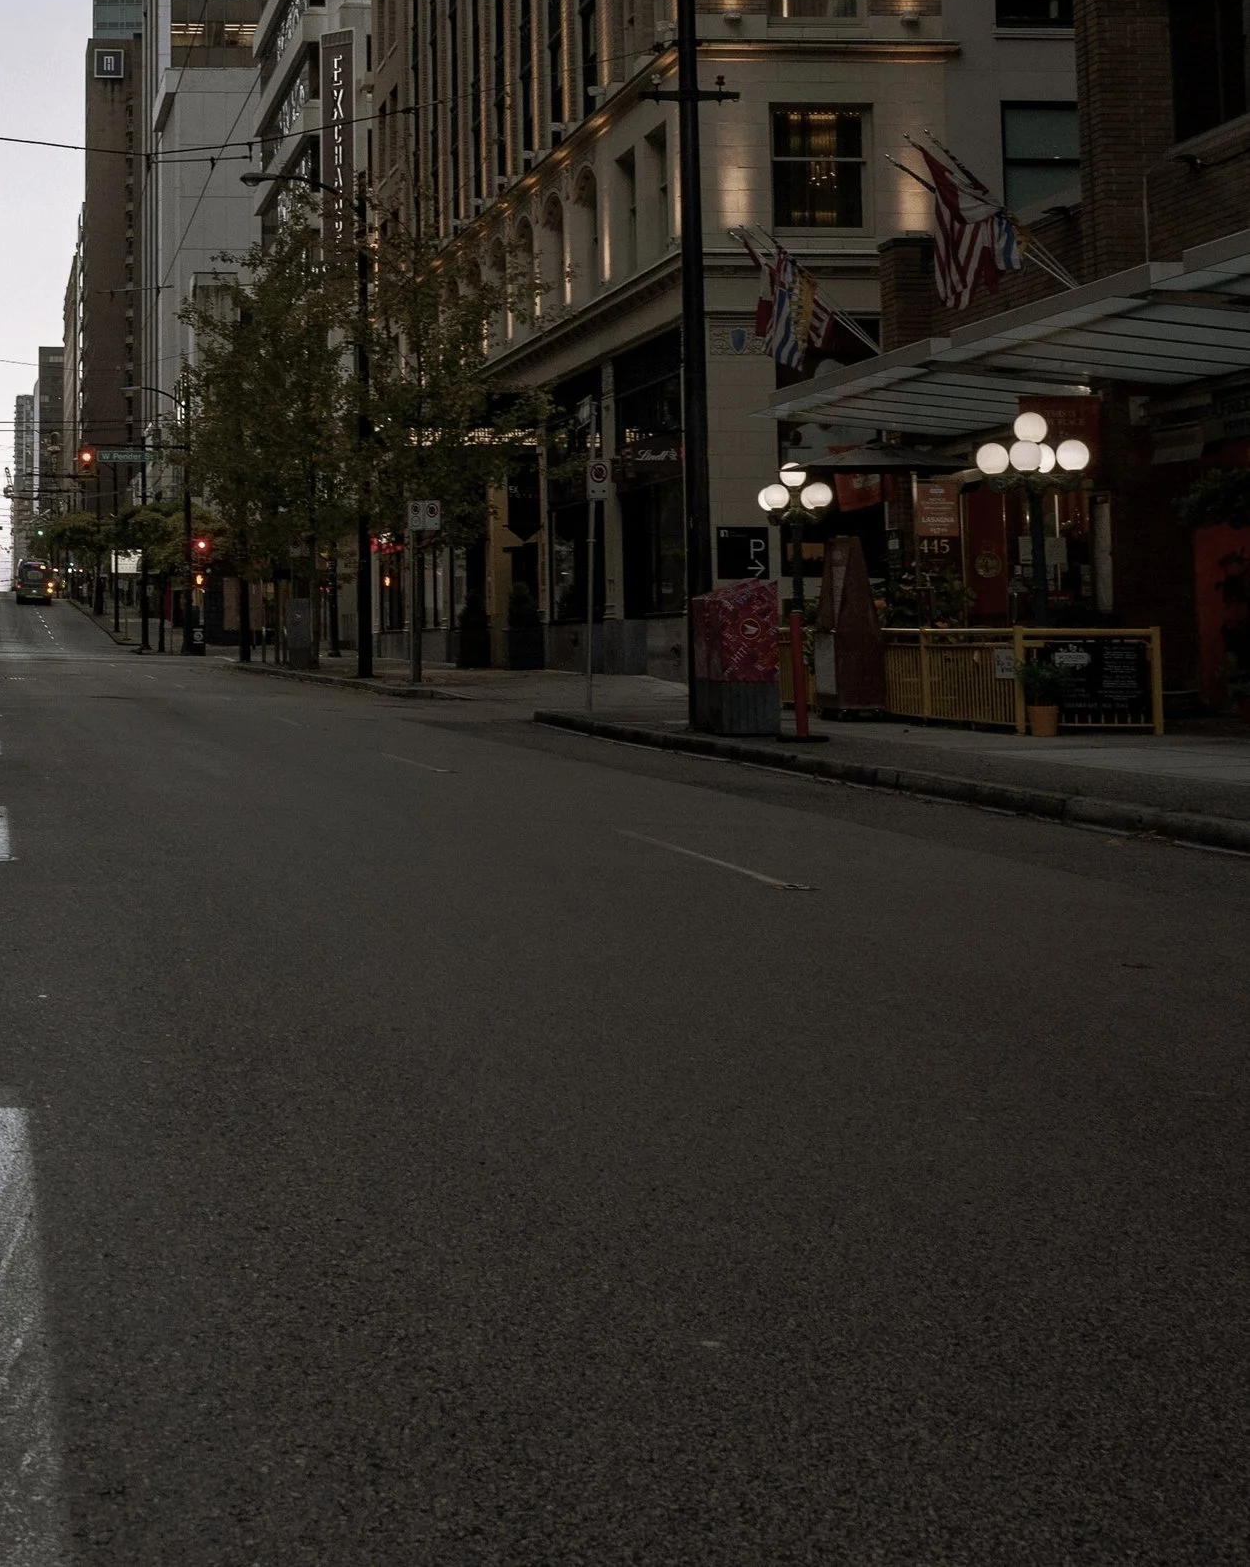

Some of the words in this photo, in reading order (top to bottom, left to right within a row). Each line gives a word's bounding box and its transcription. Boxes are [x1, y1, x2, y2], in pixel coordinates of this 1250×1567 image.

[101, 452, 111, 460] W
[112, 452, 141, 460] Pender
[750, 538, 766, 560] P
[919, 538, 950, 554] 445
